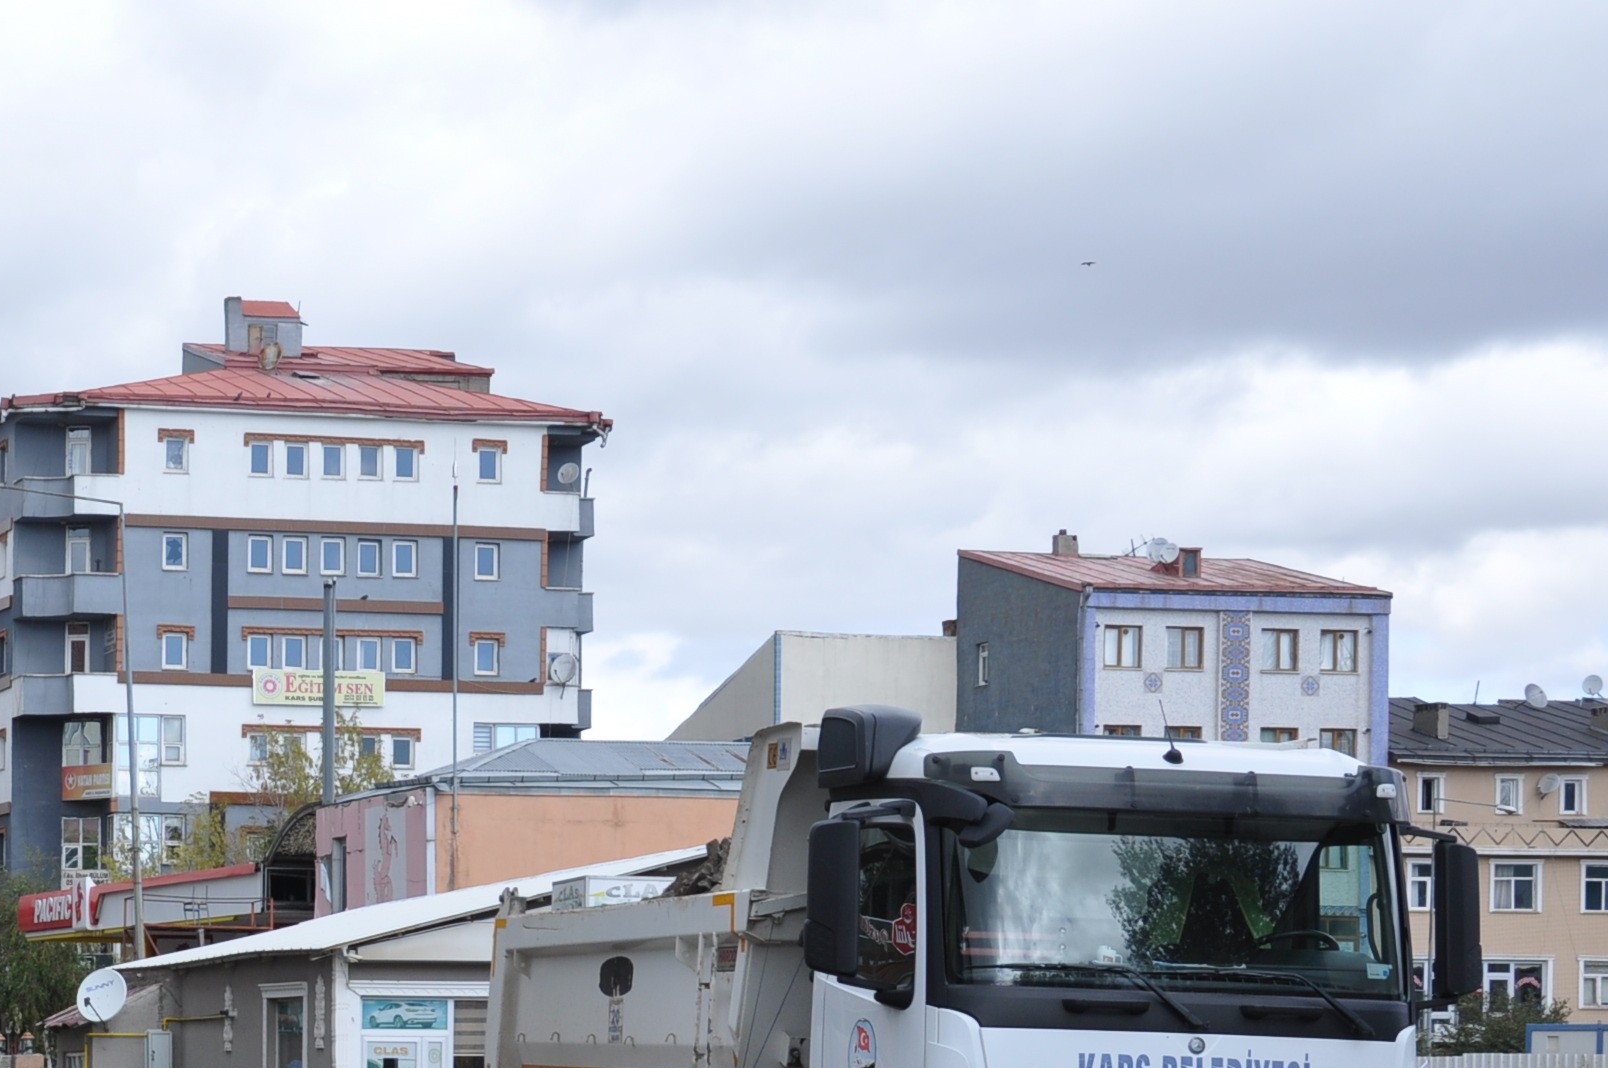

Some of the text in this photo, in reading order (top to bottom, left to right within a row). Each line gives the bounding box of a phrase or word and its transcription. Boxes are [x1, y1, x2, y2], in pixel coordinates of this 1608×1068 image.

[284, 672, 374, 695] EĞİTM SEN
[606, 883, 660, 899] CLA
[34, 895, 72, 924] PACIFIC
